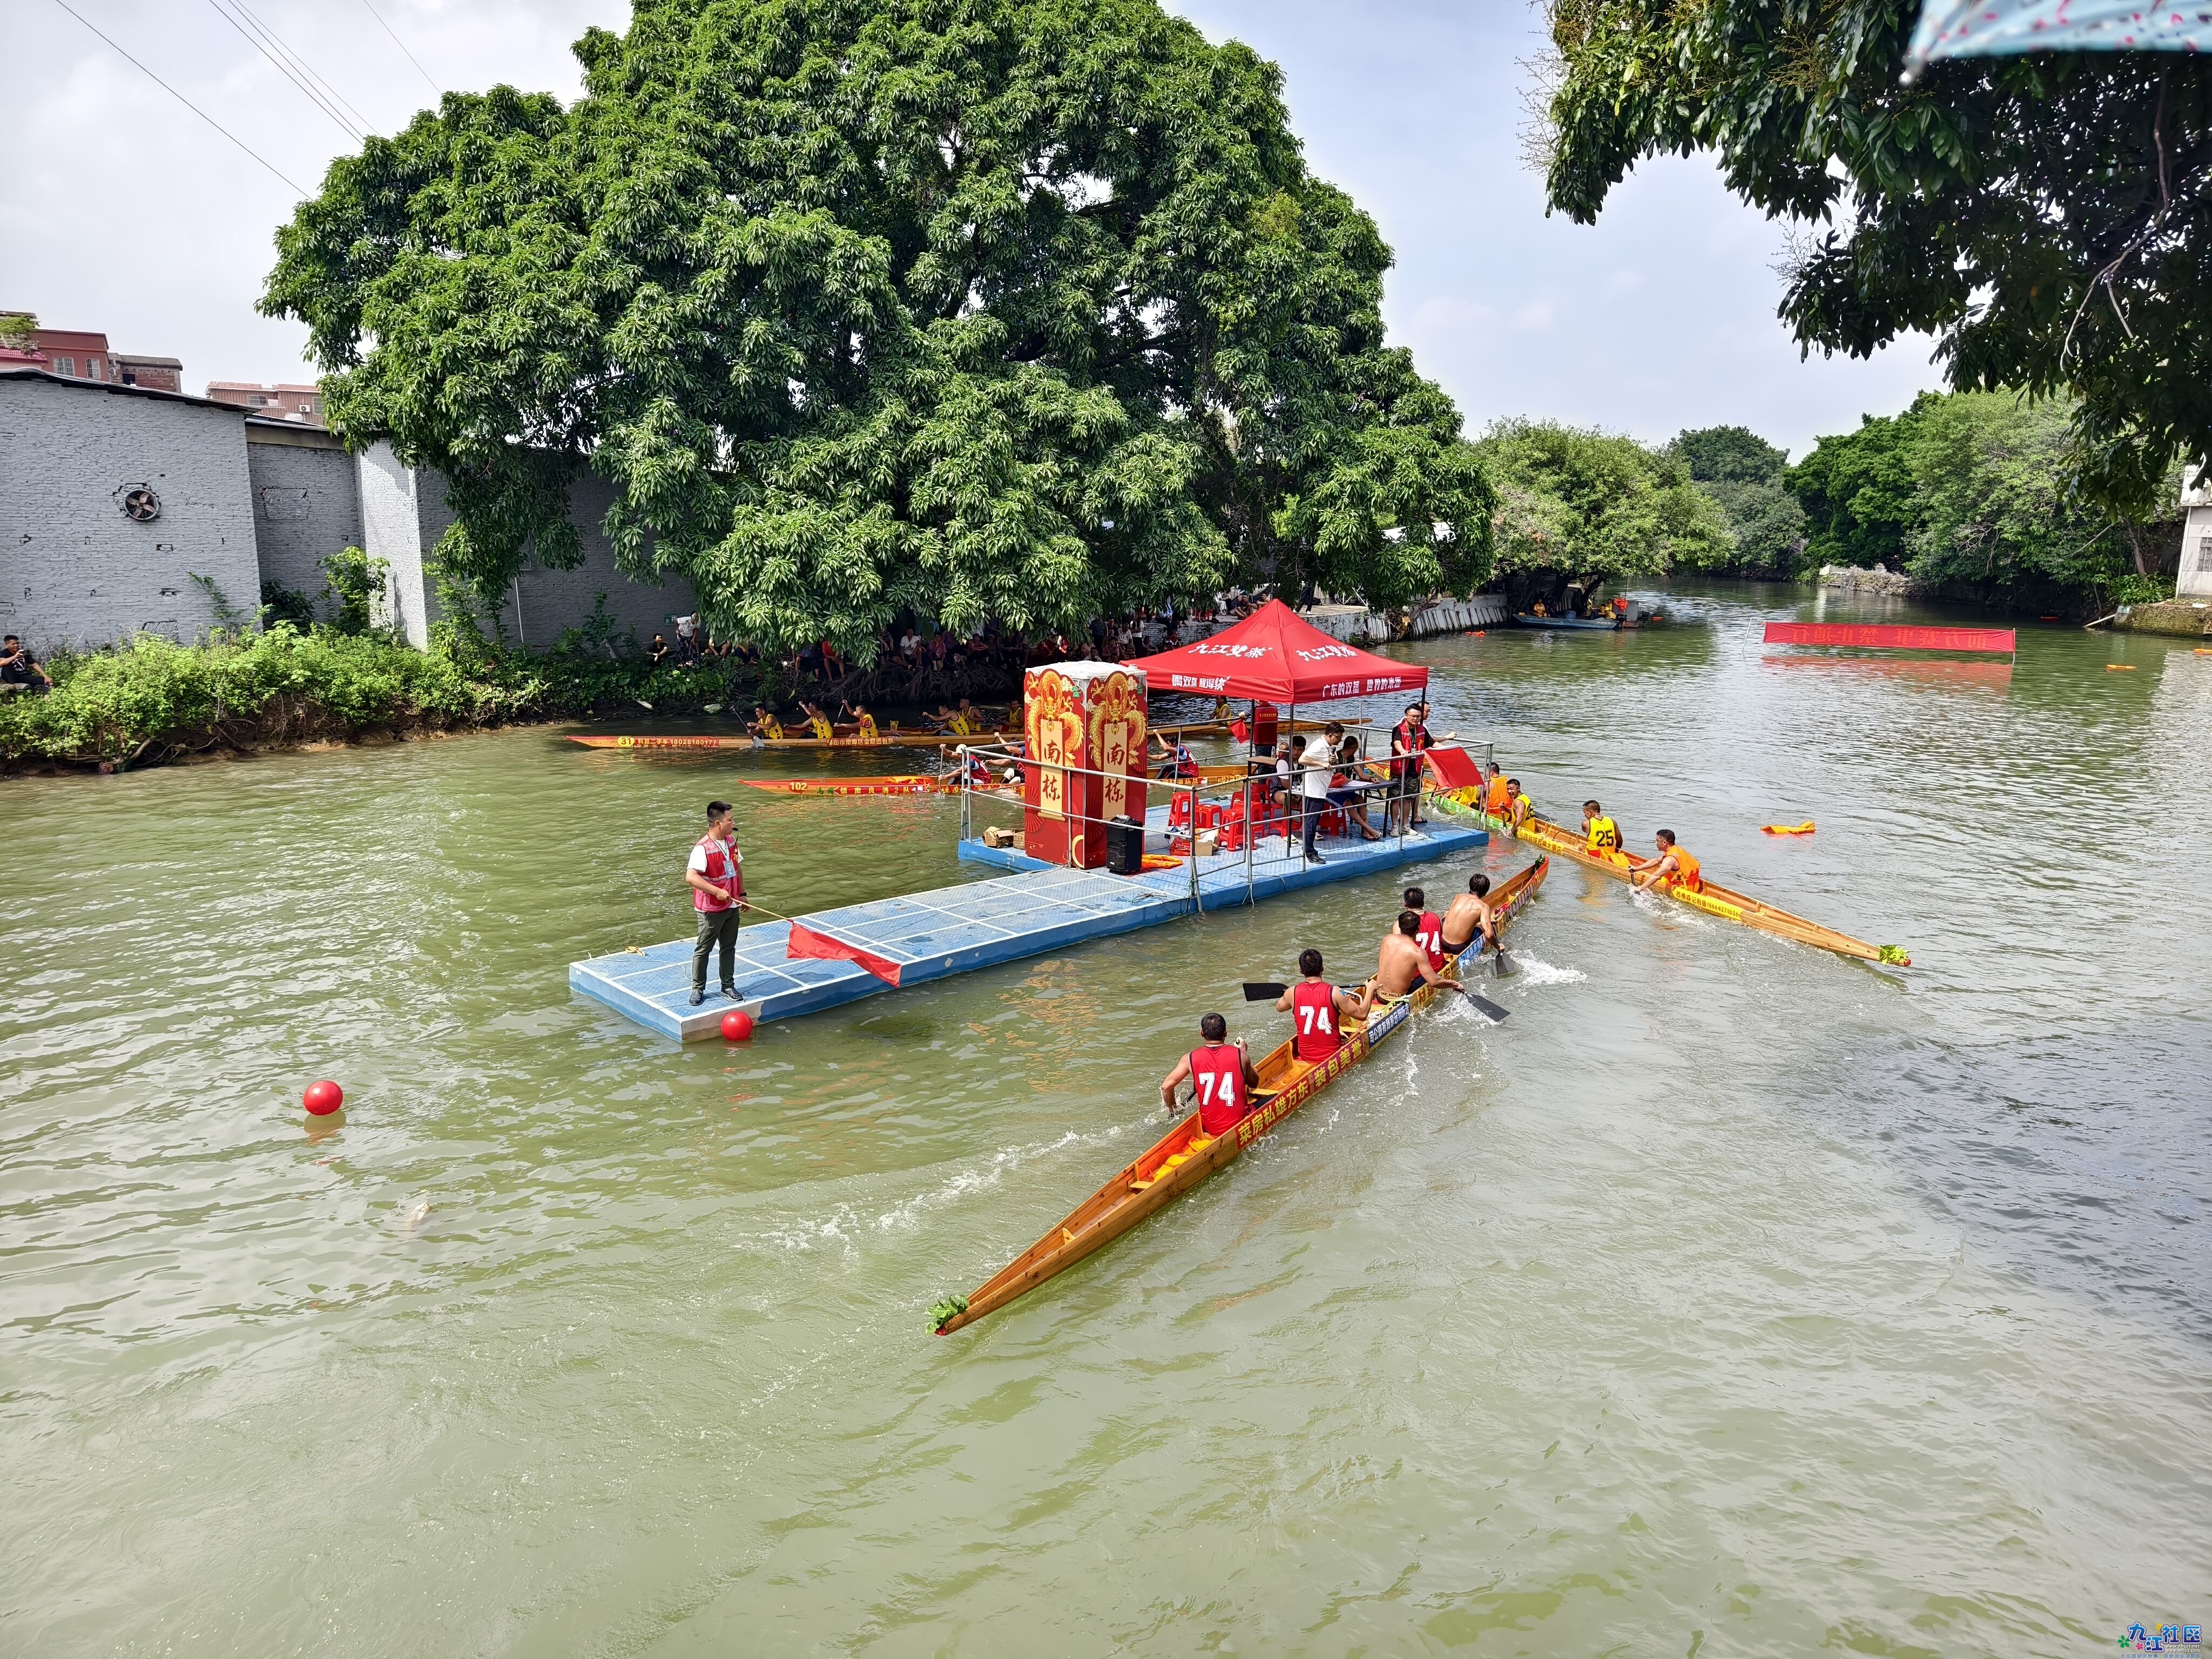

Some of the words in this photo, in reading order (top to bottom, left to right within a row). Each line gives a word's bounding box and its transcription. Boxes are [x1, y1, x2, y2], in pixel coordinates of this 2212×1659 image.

[1172, 674, 1197, 687] 喝双蒸
[1199, 676, 1231, 691] 醒得快
[1323, 680, 1360, 697] 广东的双蒸
[1366, 677, 1402, 692] 世界的米香
[1042, 739, 1061, 801] 南栋
[1105, 742, 1125, 803] 南栋
[790, 782, 808, 790] 102
[1596, 830, 1614, 847] 25
[1415, 930, 1441, 955] 74
[1299, 1006, 1332, 1035] 74
[1198, 1071, 1235, 1107] 74
